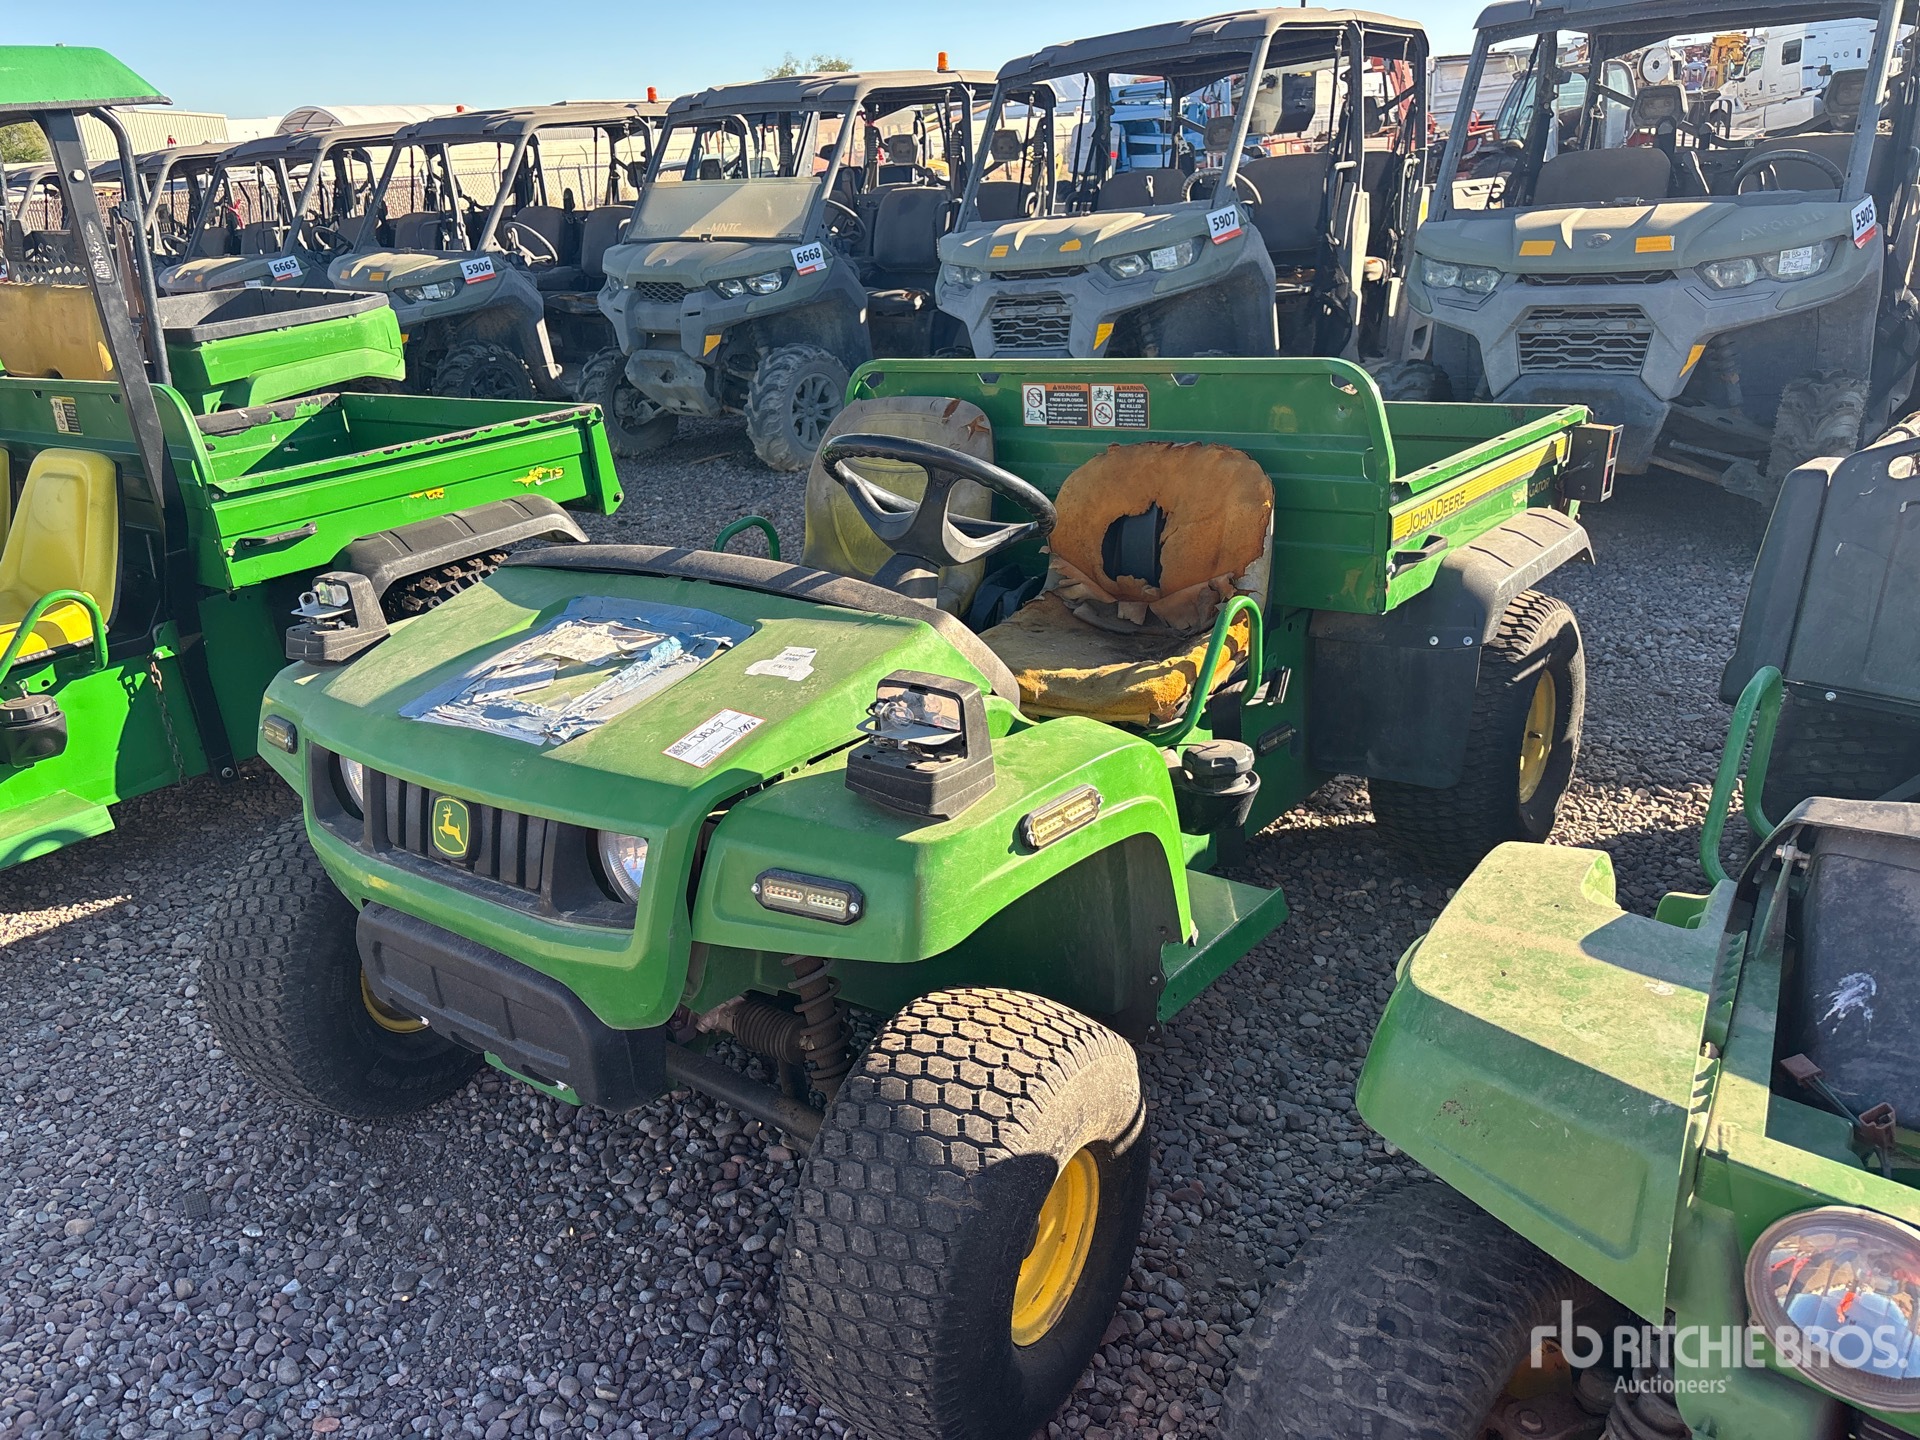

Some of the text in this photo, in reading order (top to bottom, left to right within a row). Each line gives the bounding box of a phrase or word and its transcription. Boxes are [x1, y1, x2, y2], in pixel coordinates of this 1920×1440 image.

[1212, 211, 1236, 232] 5907
[1855, 203, 1874, 231] 5905
[796, 247, 821, 264] 6668
[273, 260, 297, 273] 6665
[465, 260, 491, 275] 5906
[1529, 477, 1551, 498] GATOR
[1407, 489, 1467, 535] JOHN DEERE
